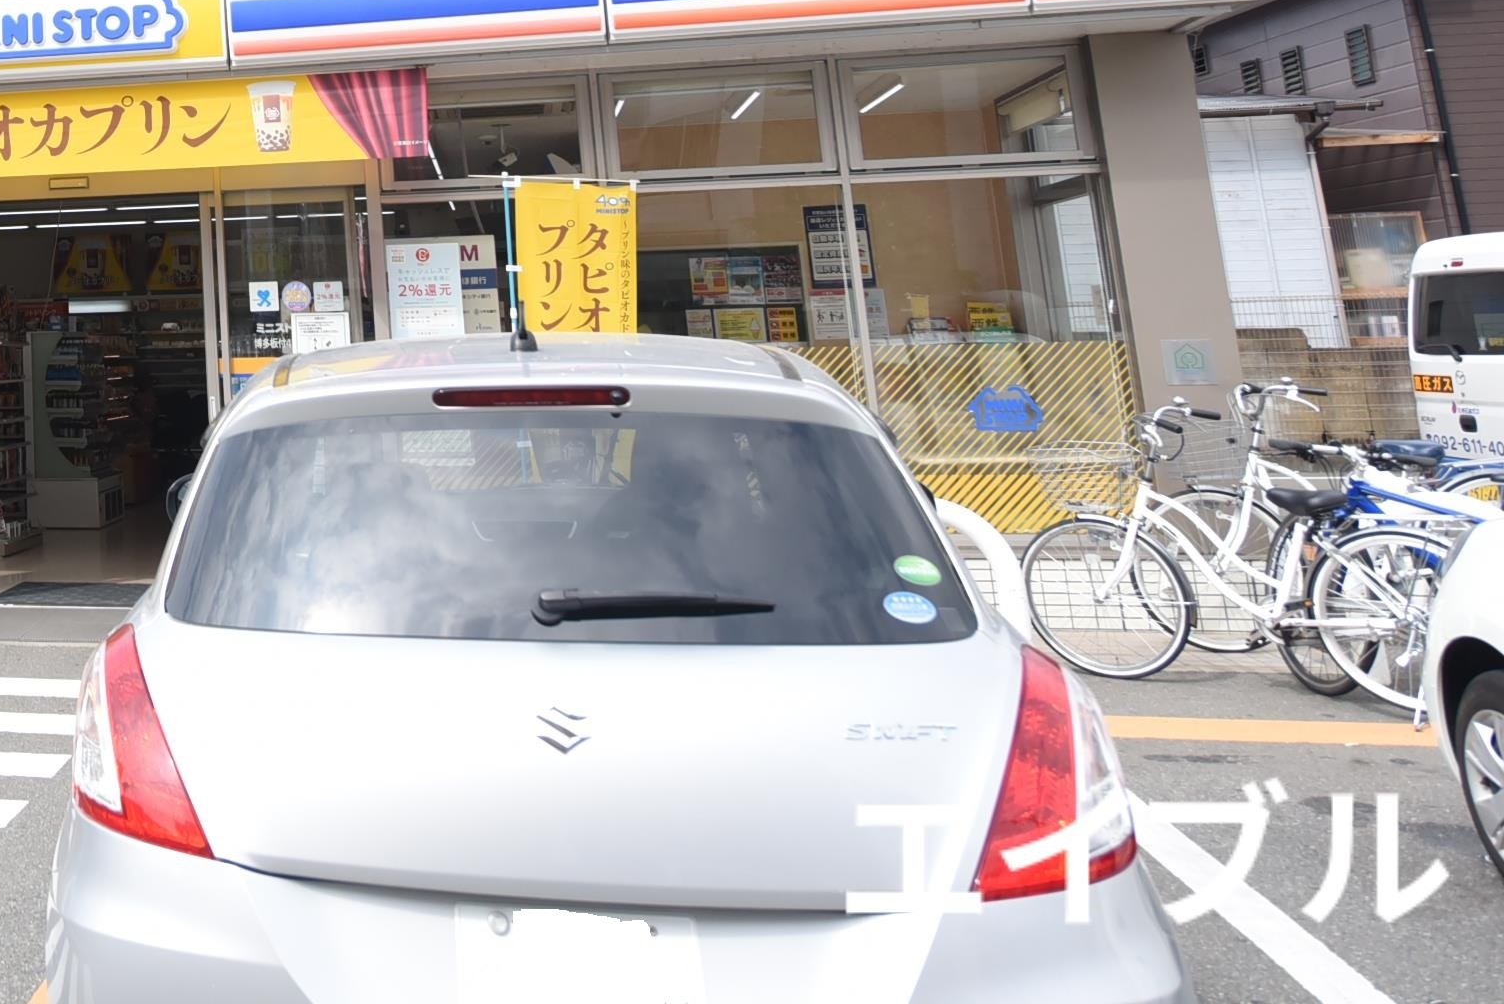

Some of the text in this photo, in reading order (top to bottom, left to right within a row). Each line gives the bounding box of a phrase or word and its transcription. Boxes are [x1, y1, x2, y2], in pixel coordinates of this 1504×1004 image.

[52, 4, 159, 44] STOP
[536, 219, 576, 332] プリン
[398, 284, 452, 297] 2%還元
[1414, 375, 1453, 392] 高圧ガス
